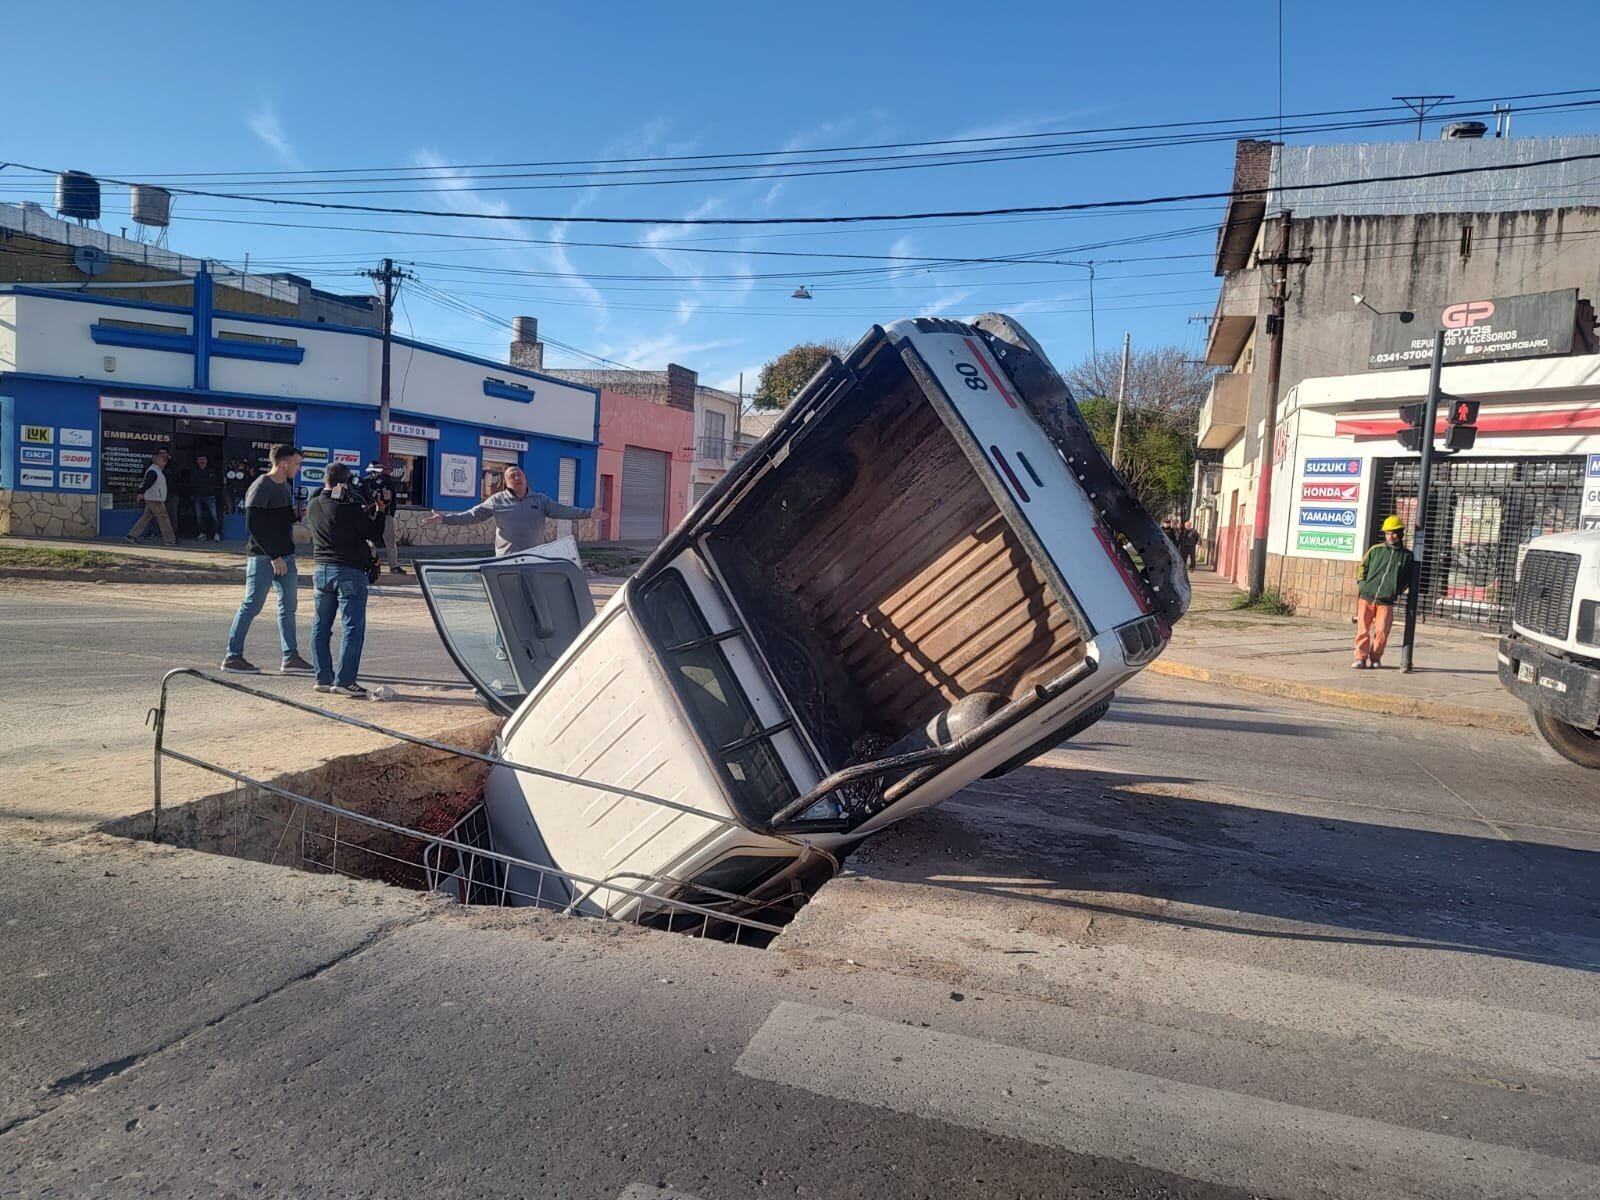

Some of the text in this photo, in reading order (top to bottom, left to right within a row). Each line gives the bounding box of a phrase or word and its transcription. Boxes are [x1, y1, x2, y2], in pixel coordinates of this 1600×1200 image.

[1442, 300, 1494, 329] GP
[1464, 330, 1517, 345] ACCESORIOS
[134, 401, 293, 422] ITALIA REPUESTOS
[103, 430, 170, 442] EMBRAGUES
[391, 424, 426, 436] FRENOS
[1306, 462, 1346, 472] SUZUKI
[62, 473, 82, 485] FTE
[1303, 487, 1342, 497] HONDA
[1302, 511, 1342, 522] YAMAHA
[1299, 535, 1338, 547] KAWASAKI
